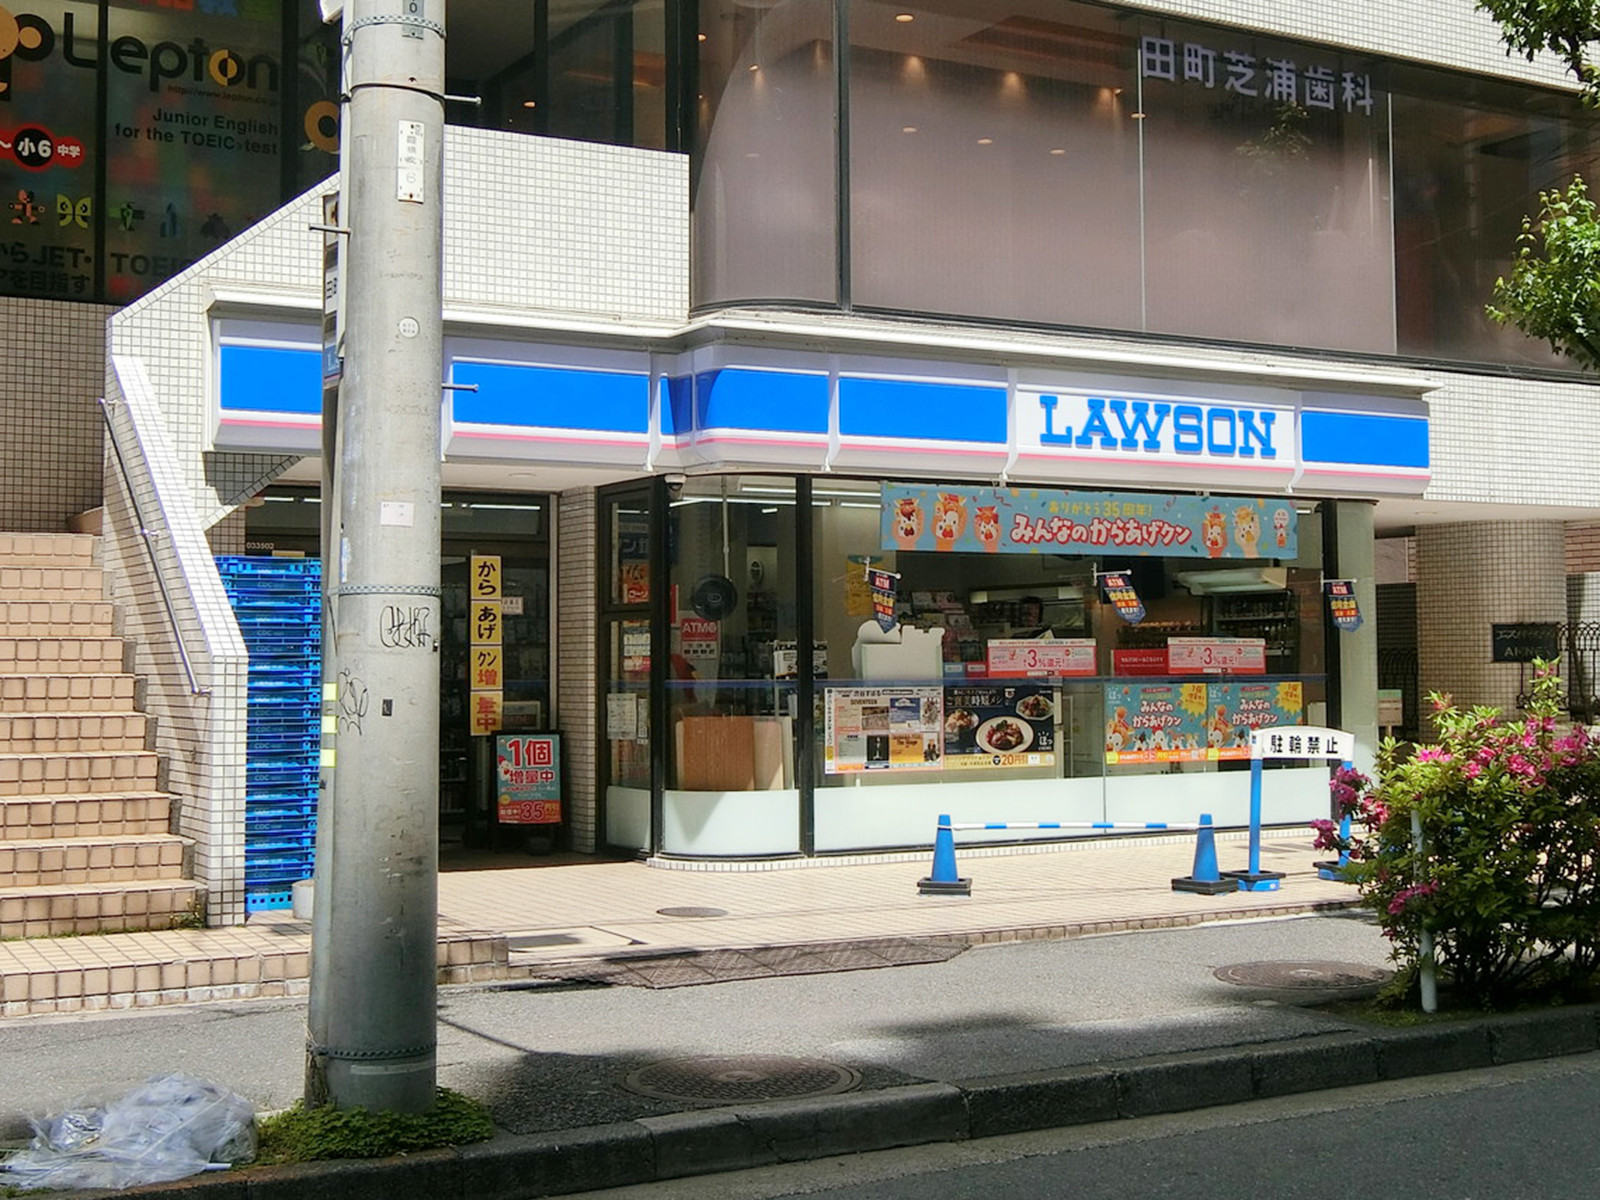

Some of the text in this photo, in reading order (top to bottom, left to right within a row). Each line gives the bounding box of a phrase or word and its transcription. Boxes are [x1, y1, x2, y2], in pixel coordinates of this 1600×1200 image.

[64, 12, 278, 92] Lepton
[1141, 35, 1374, 116] 田町芝浦歯科
[153, 108, 279, 136] Junior English
[115, 123, 140, 138] for
[147, 127, 174, 142] the
[246, 139, 278, 155] test
[57, 145, 82, 159] 中学
[1039, 395, 1277, 458] LAWSON
[1011, 514, 1191, 547] みんなのからあげクン
[246, 541, 275, 550] 033502
[682, 621, 709, 634] ATM
[1140, 700, 1174, 713] みんなの
[1239, 699, 1271, 711] みんなの
[1132, 715, 1181, 728] からあげクン
[1232, 712, 1278, 726] からあげクン
[507, 738, 553, 767] 1個
[1270, 735, 1338, 754] 駐輪禁止
[509, 769, 555, 785] 増量中
